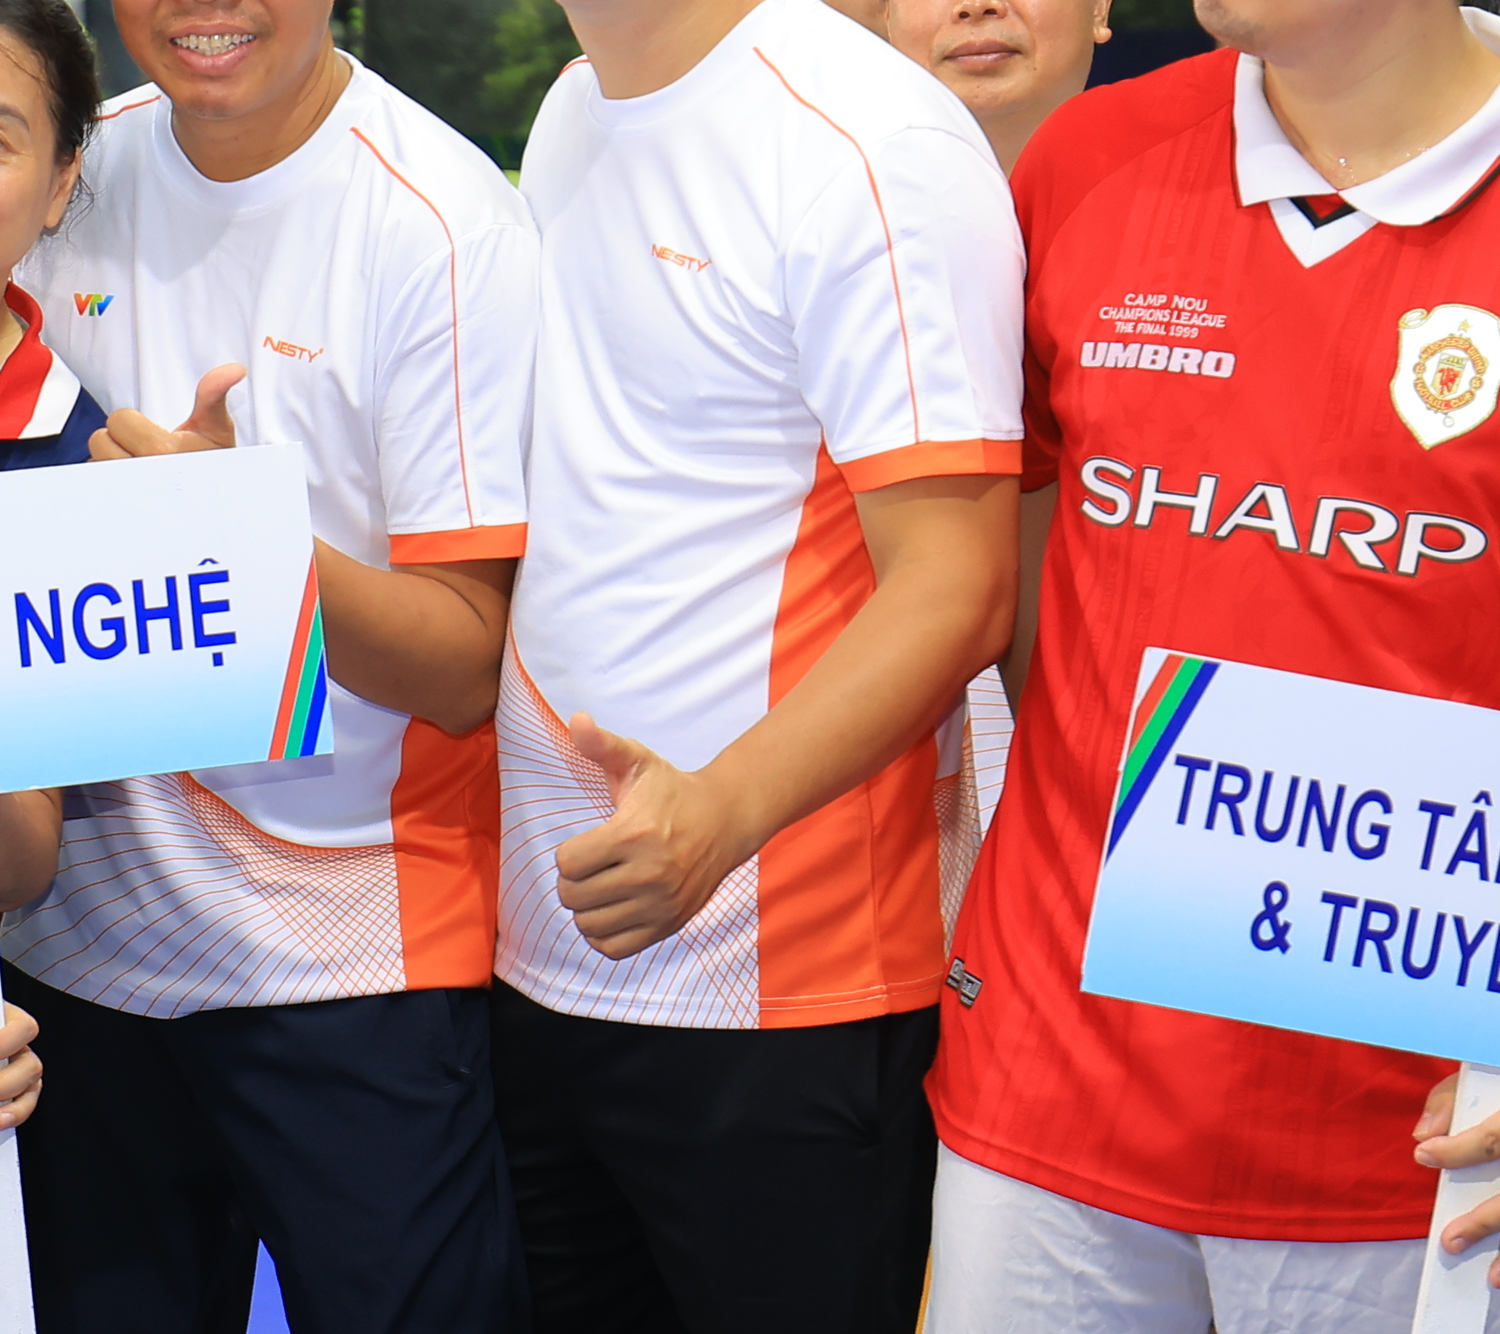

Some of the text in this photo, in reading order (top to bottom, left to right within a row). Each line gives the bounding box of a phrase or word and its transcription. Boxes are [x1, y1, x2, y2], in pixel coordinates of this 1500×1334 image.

[651, 243, 712, 273] NESTY
[73, 292, 115, 316] VTV
[1099, 306, 1227, 328] CHAMPIONS LEAGUE
[1124, 293, 1208, 312] CAMP NOU
[1114, 321, 1199, 338] THE FINAL 1999
[263, 336, 319, 363] NESTY
[1080, 341, 1236, 379] UMBRO
[1080, 456, 1488, 578] SHARP
[15, 558, 237, 668] NGHỆ
[1174, 754, 1394, 861] TRUNG
[1250, 881, 1292, 955] &
